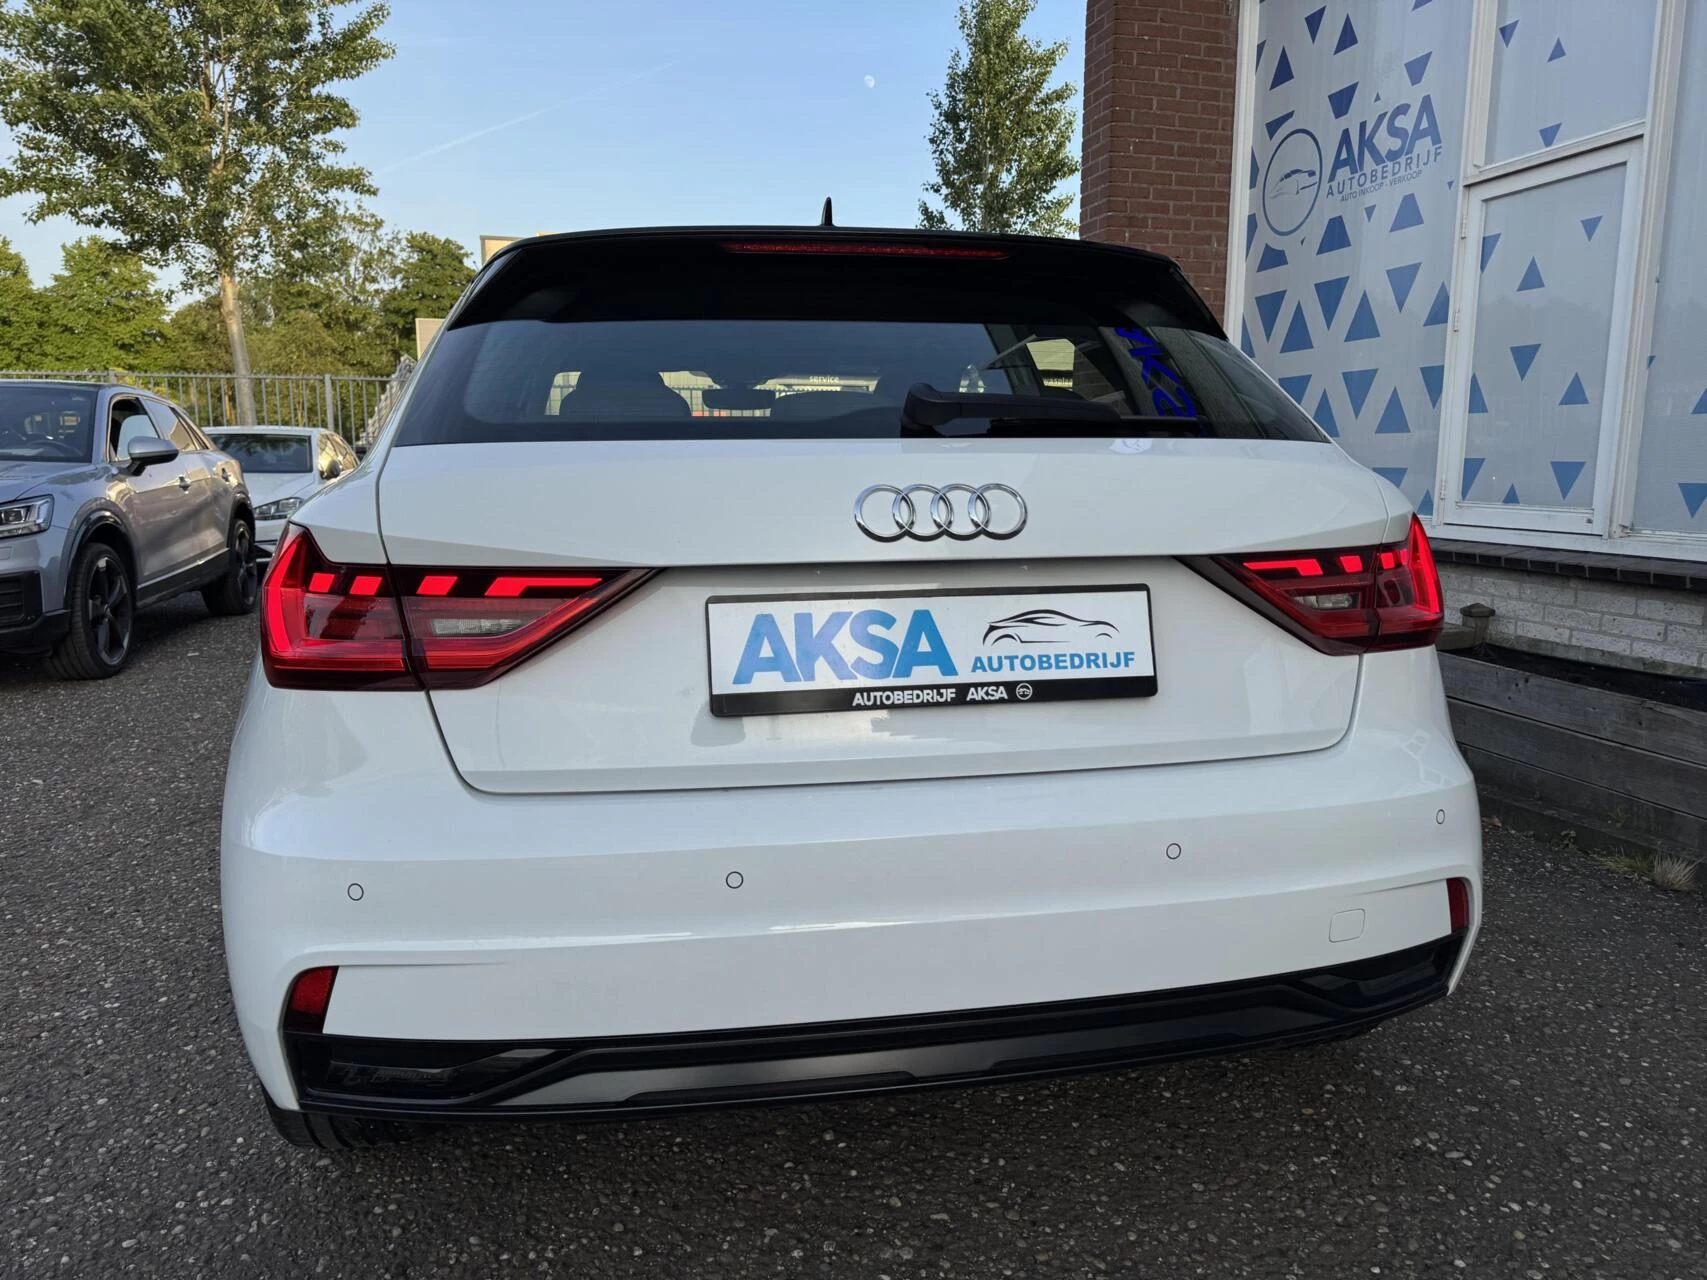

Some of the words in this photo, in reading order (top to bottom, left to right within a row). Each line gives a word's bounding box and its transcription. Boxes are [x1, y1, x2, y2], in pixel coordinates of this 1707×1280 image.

[1327, 94, 1441, 183] AKSA
[1326, 146, 1442, 198] AUTOBEDRIJF
[1340, 191, 1358, 202] AUTO
[1358, 183, 1384, 197] INKOOP
[1389, 169, 1423, 187] VERKOOP
[809, 374, 840, 384] service
[732, 609, 957, 684] AKSA
[971, 651, 1135, 673] AUTOBEDRIJF
[852, 688, 956, 706] AUTOBEDRIJF
[966, 685, 1007, 701] AKSA
